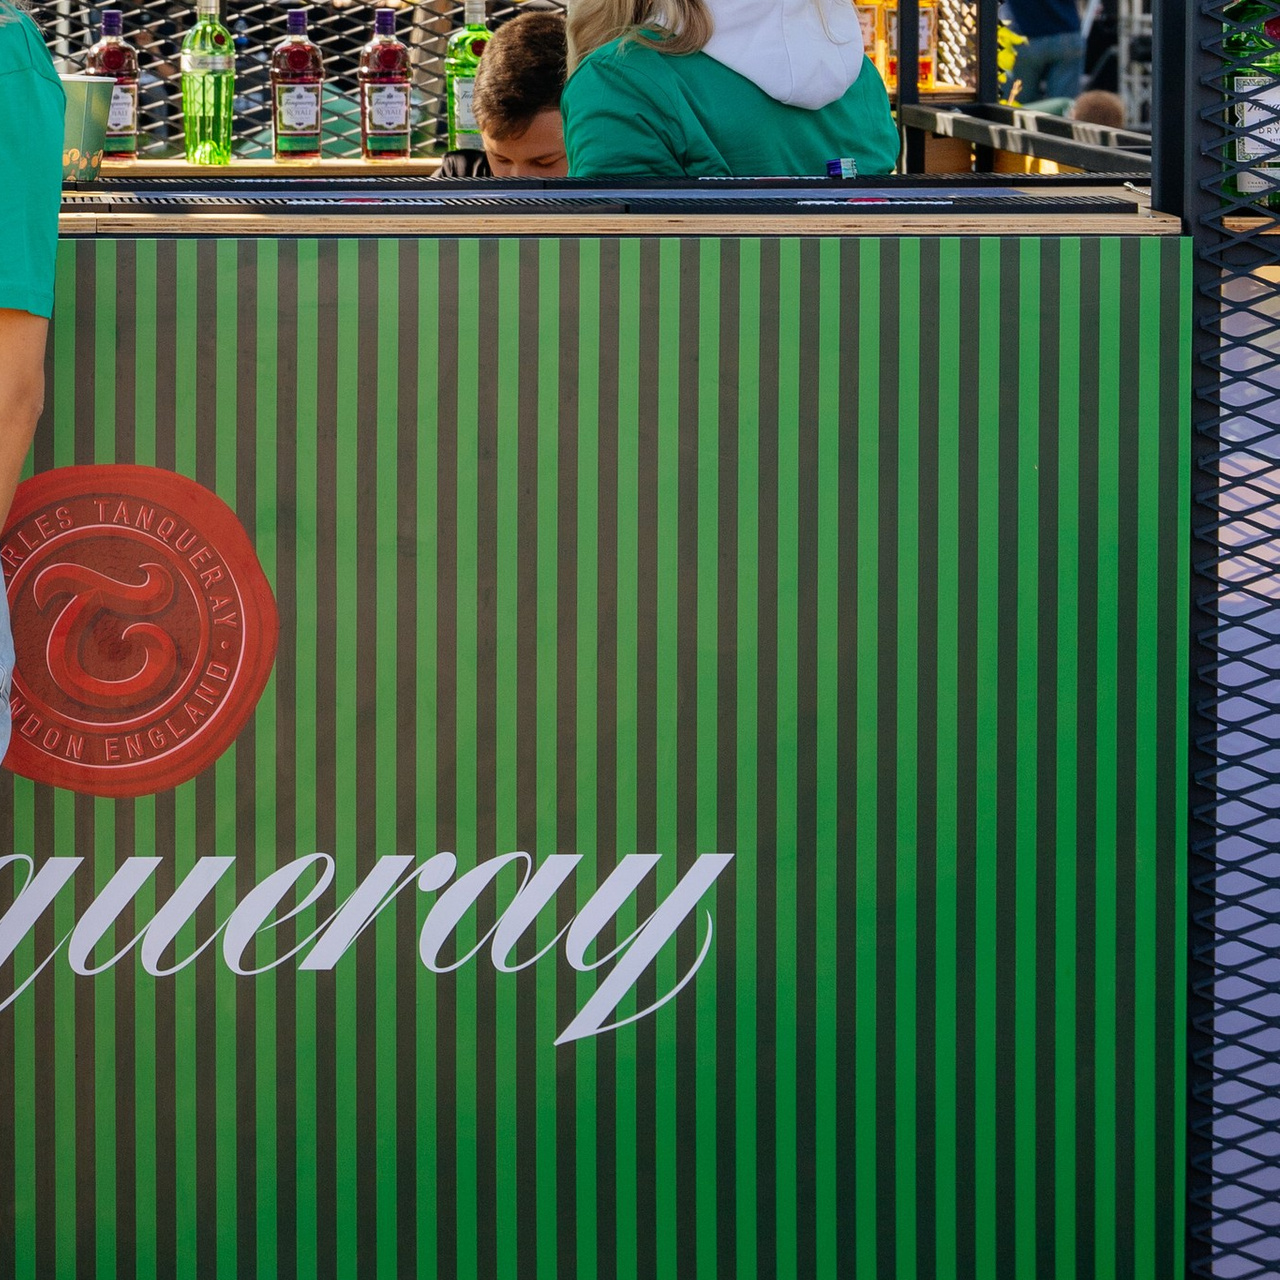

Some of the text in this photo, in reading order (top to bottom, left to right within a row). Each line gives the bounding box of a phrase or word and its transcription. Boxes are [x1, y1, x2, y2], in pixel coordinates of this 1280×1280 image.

[0, 501, 237, 629] RLES TANQUERAY
[10, 661, 230, 761] NDON ENGLAND
